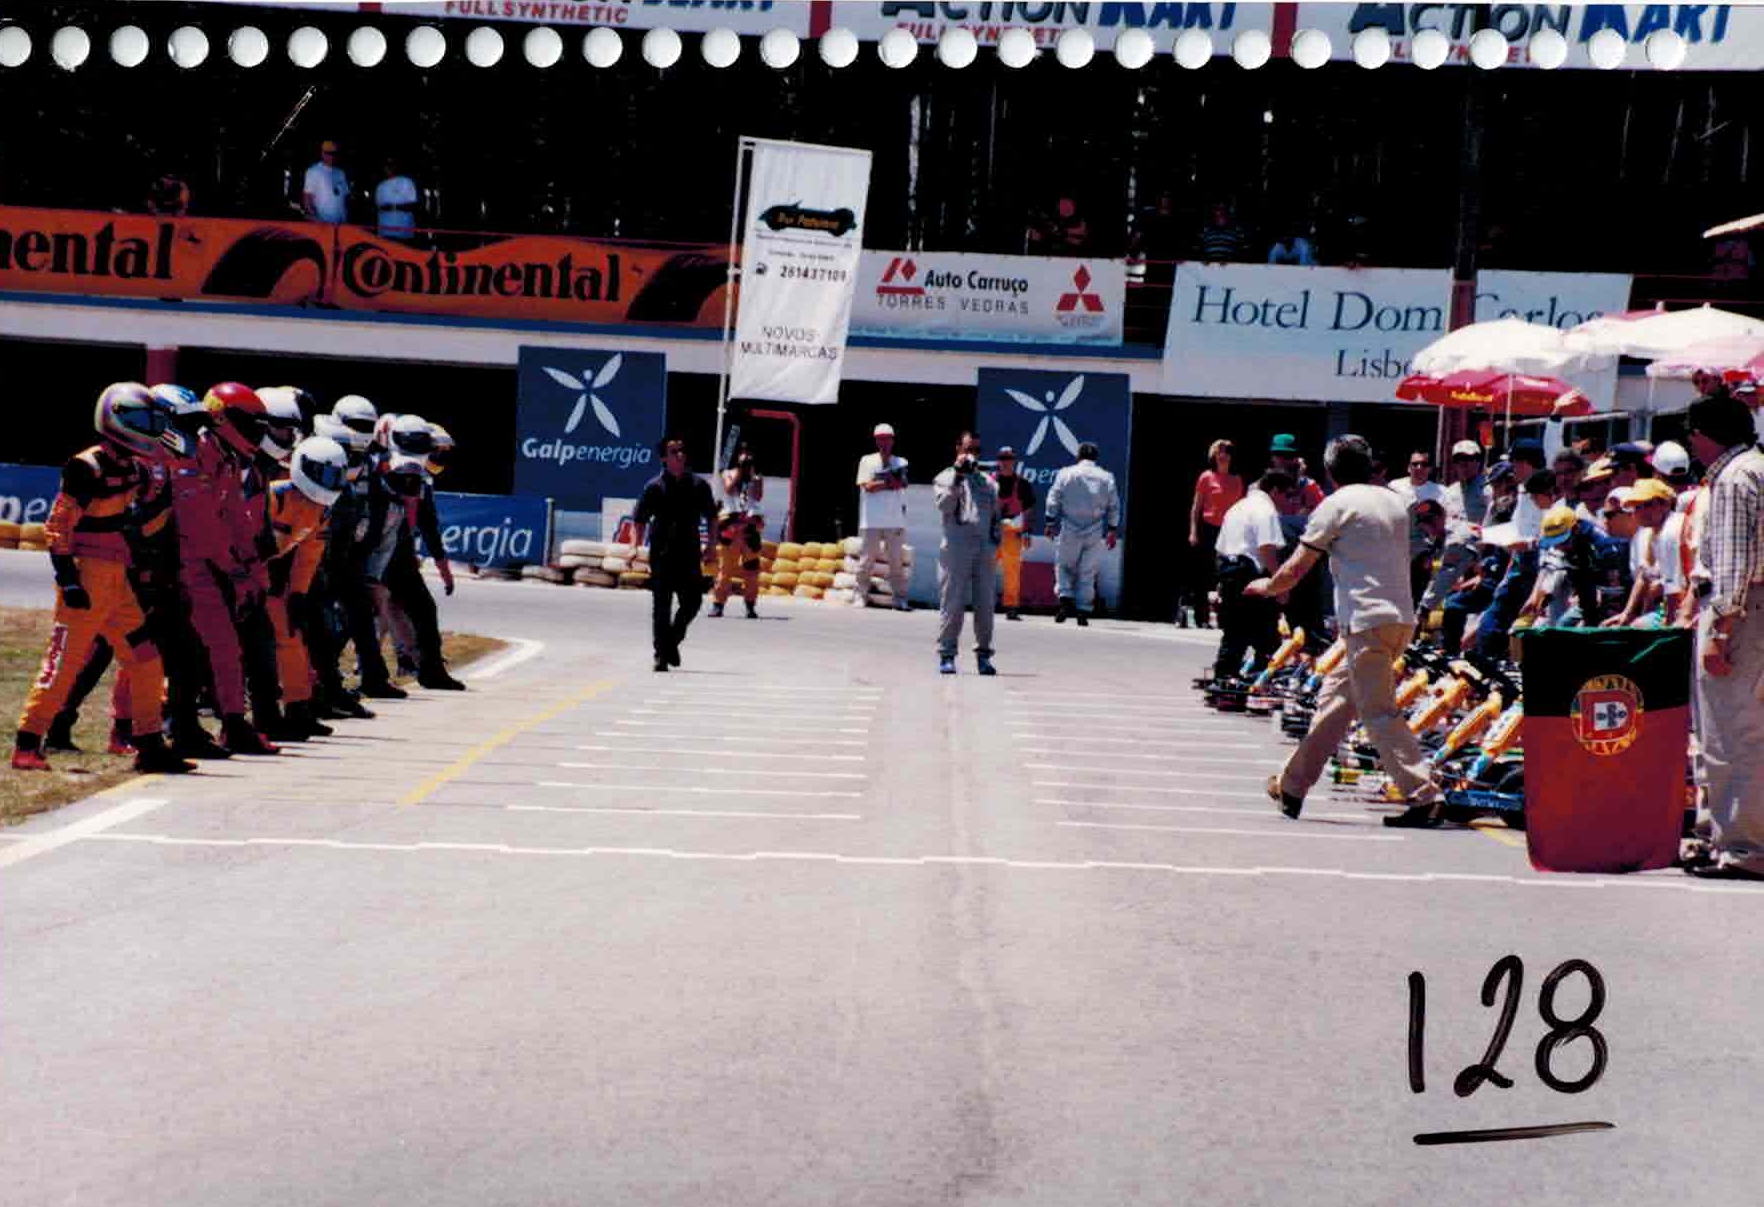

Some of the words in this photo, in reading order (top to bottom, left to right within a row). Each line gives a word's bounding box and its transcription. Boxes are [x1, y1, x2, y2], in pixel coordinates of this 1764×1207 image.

[503, 2, 629, 24] SYNTHETIC
[343, 242, 621, 302] Continental
[924, 270, 963, 289] Auto
[967, 270, 1029, 298] Carruço
[876, 294, 947, 311] TORRES
[960, 298, 1029, 315] VEDRAS
[1192, 284, 1309, 330] Hotel
[1330, 291, 1444, 333] Dom
[521, 437, 652, 469] Galpenergia
[1408, 954, 1609, 1099] 128
